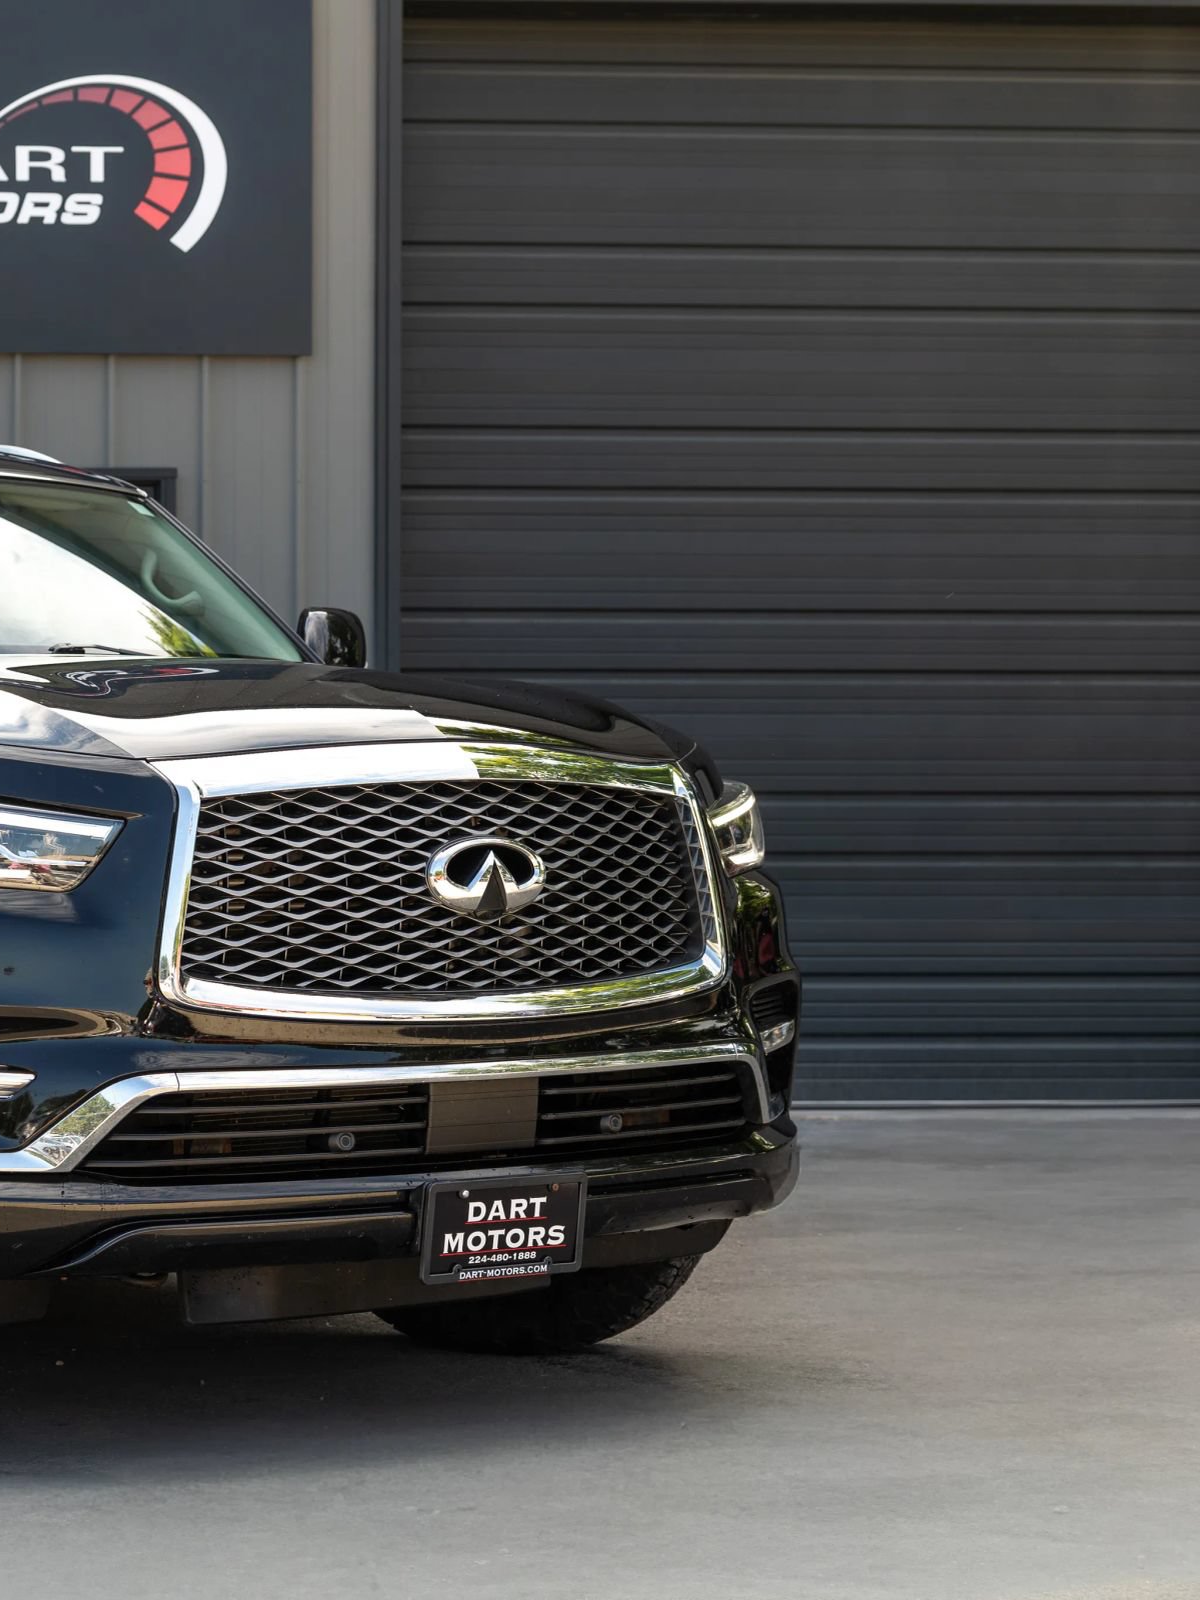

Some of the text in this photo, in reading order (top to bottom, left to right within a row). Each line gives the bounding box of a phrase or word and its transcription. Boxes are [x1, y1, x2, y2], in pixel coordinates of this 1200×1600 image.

[467, 1196, 548, 1223] DART
[442, 1225, 566, 1254] MOTORS
[468, 1251, 537, 1264] 224-480-1888
[459, 1264, 548, 1280] DART-MOTORS.COM
